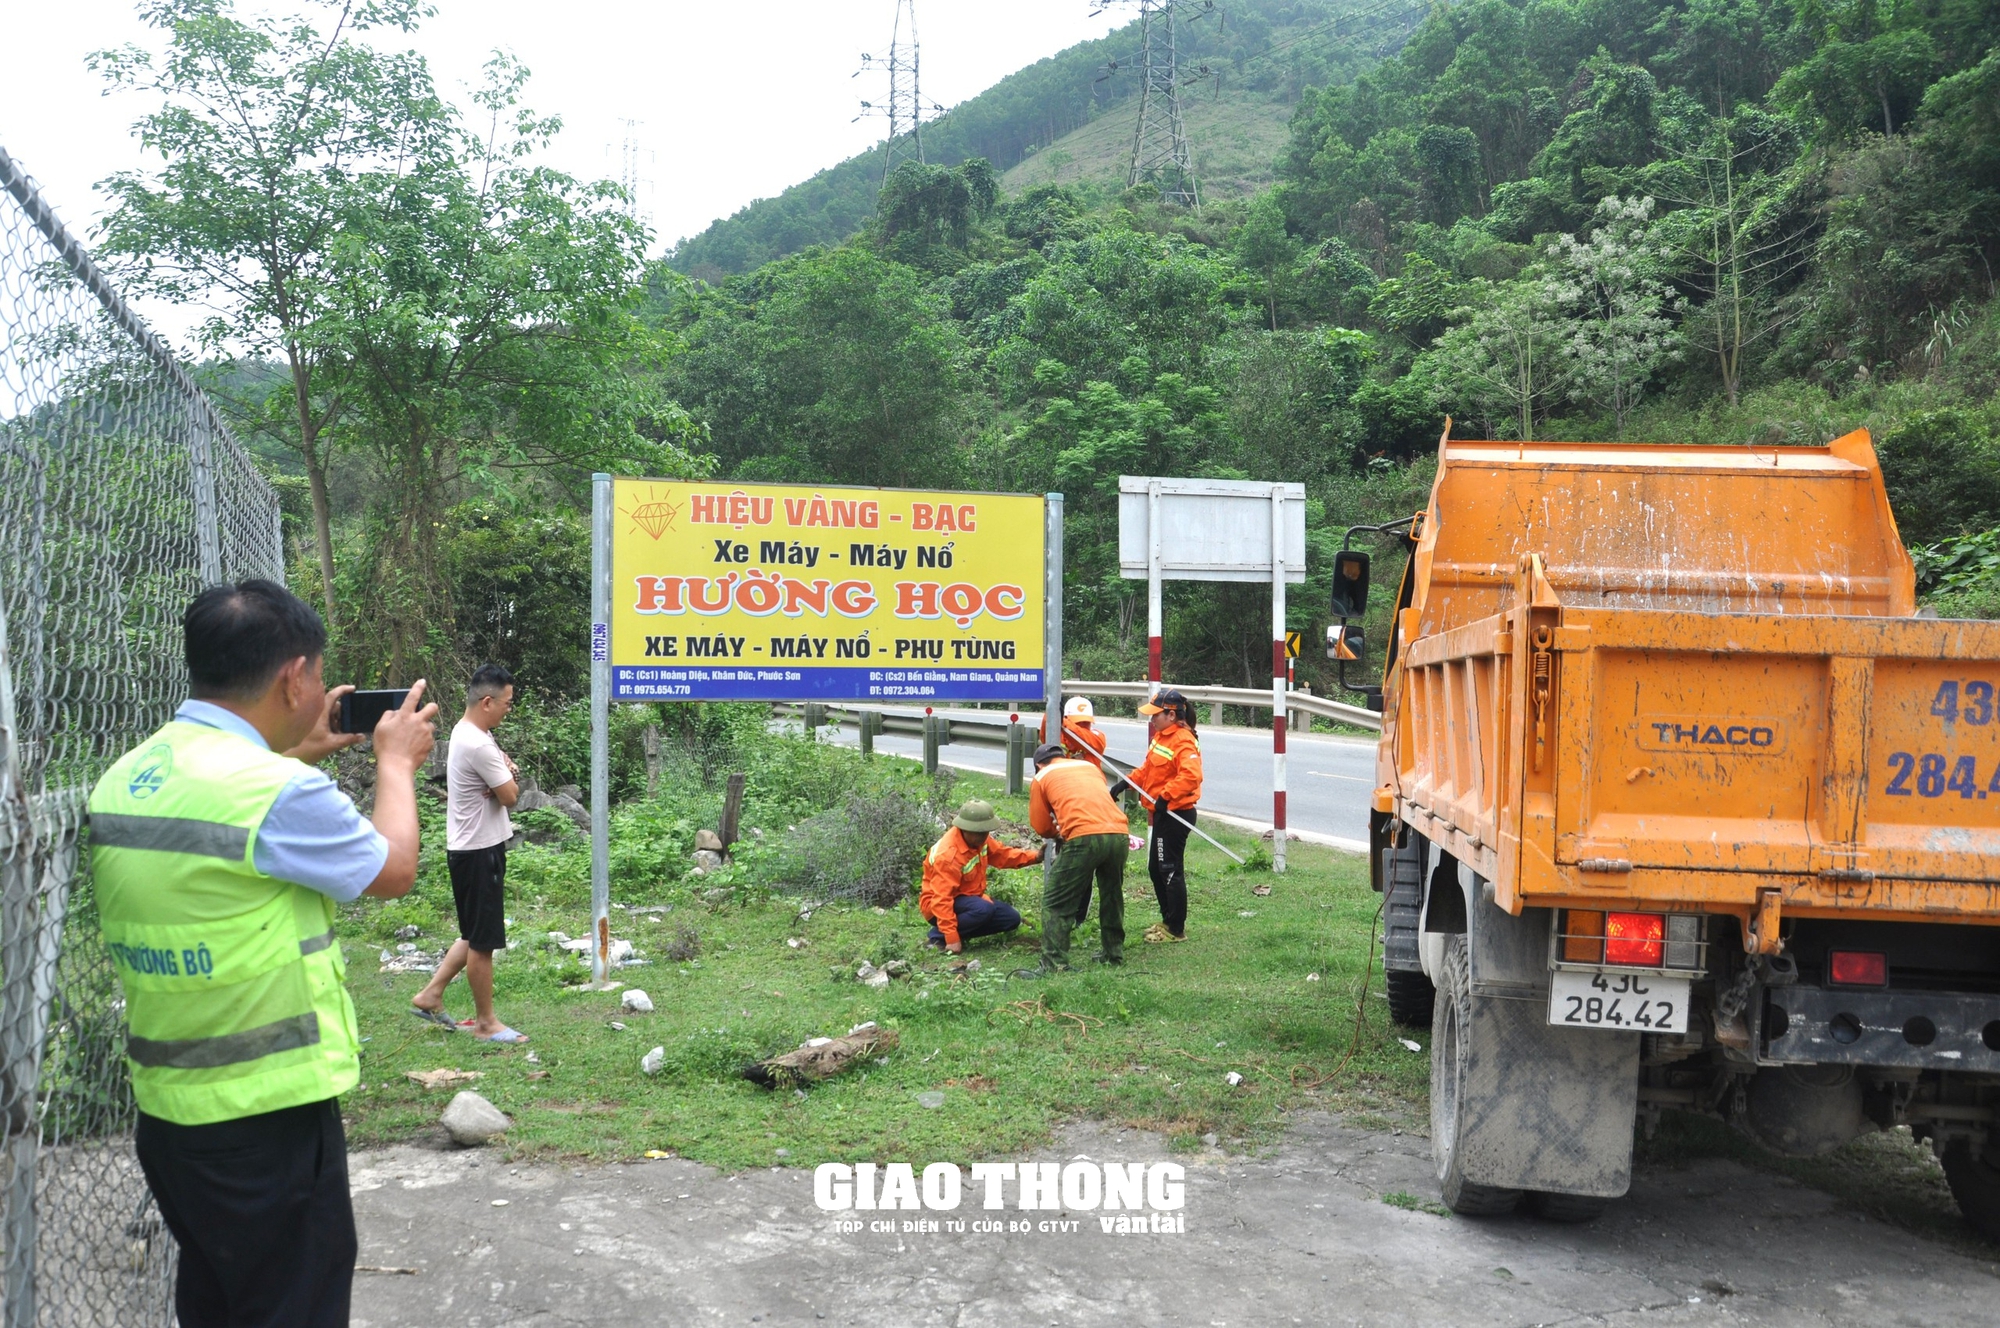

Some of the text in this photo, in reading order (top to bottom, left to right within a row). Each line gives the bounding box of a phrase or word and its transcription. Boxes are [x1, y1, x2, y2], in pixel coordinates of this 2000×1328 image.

[690, 490, 774, 530] HIỆU
[783, 494, 879, 529] VÀNG
[912, 503, 976, 536] BẠC
[713, 539, 749, 563] Xe
[760, 541, 820, 568] Máy
[850, 543, 907, 570] Máy
[917, 541, 955, 569] Nổ
[634, 569, 1025, 630] HƯỜNG HỌC
[645, 636, 678, 657] XE
[686, 633, 746, 657] MÁY
[770, 633, 829, 658] MÁY
[835, 629, 871, 659] NỔ
[895, 639, 944, 663] PHỤ
[951, 635, 1016, 660] TÙNG
[634, 684, 691, 695] 0975.654.770
[636, 670, 659, 681] (Cs1)
[660, 670, 687, 681] Hoàng
[688, 670, 710, 682] Diệu,
[711, 670, 736, 681] Khâm
[737, 670, 756, 681] Đức,
[757, 671, 784, 681] Phước
[785, 671, 801, 681] Sơn
[883, 685, 935, 696] 0972.304.064
[885, 672, 906, 682] (Cs2)
[907, 670, 923, 682] Bến
[949, 672, 969, 682] Nam
[969, 672, 994, 683] Giang,
[995, 671, 1019, 683] Quảng
[1019, 672, 1038, 682] Nam
[1930, 680, 2000, 726] 43
[1651, 722, 1774, 747] THACO
[182, 942, 213, 980] BỘ
[1564, 995, 1674, 1029] 284.42
